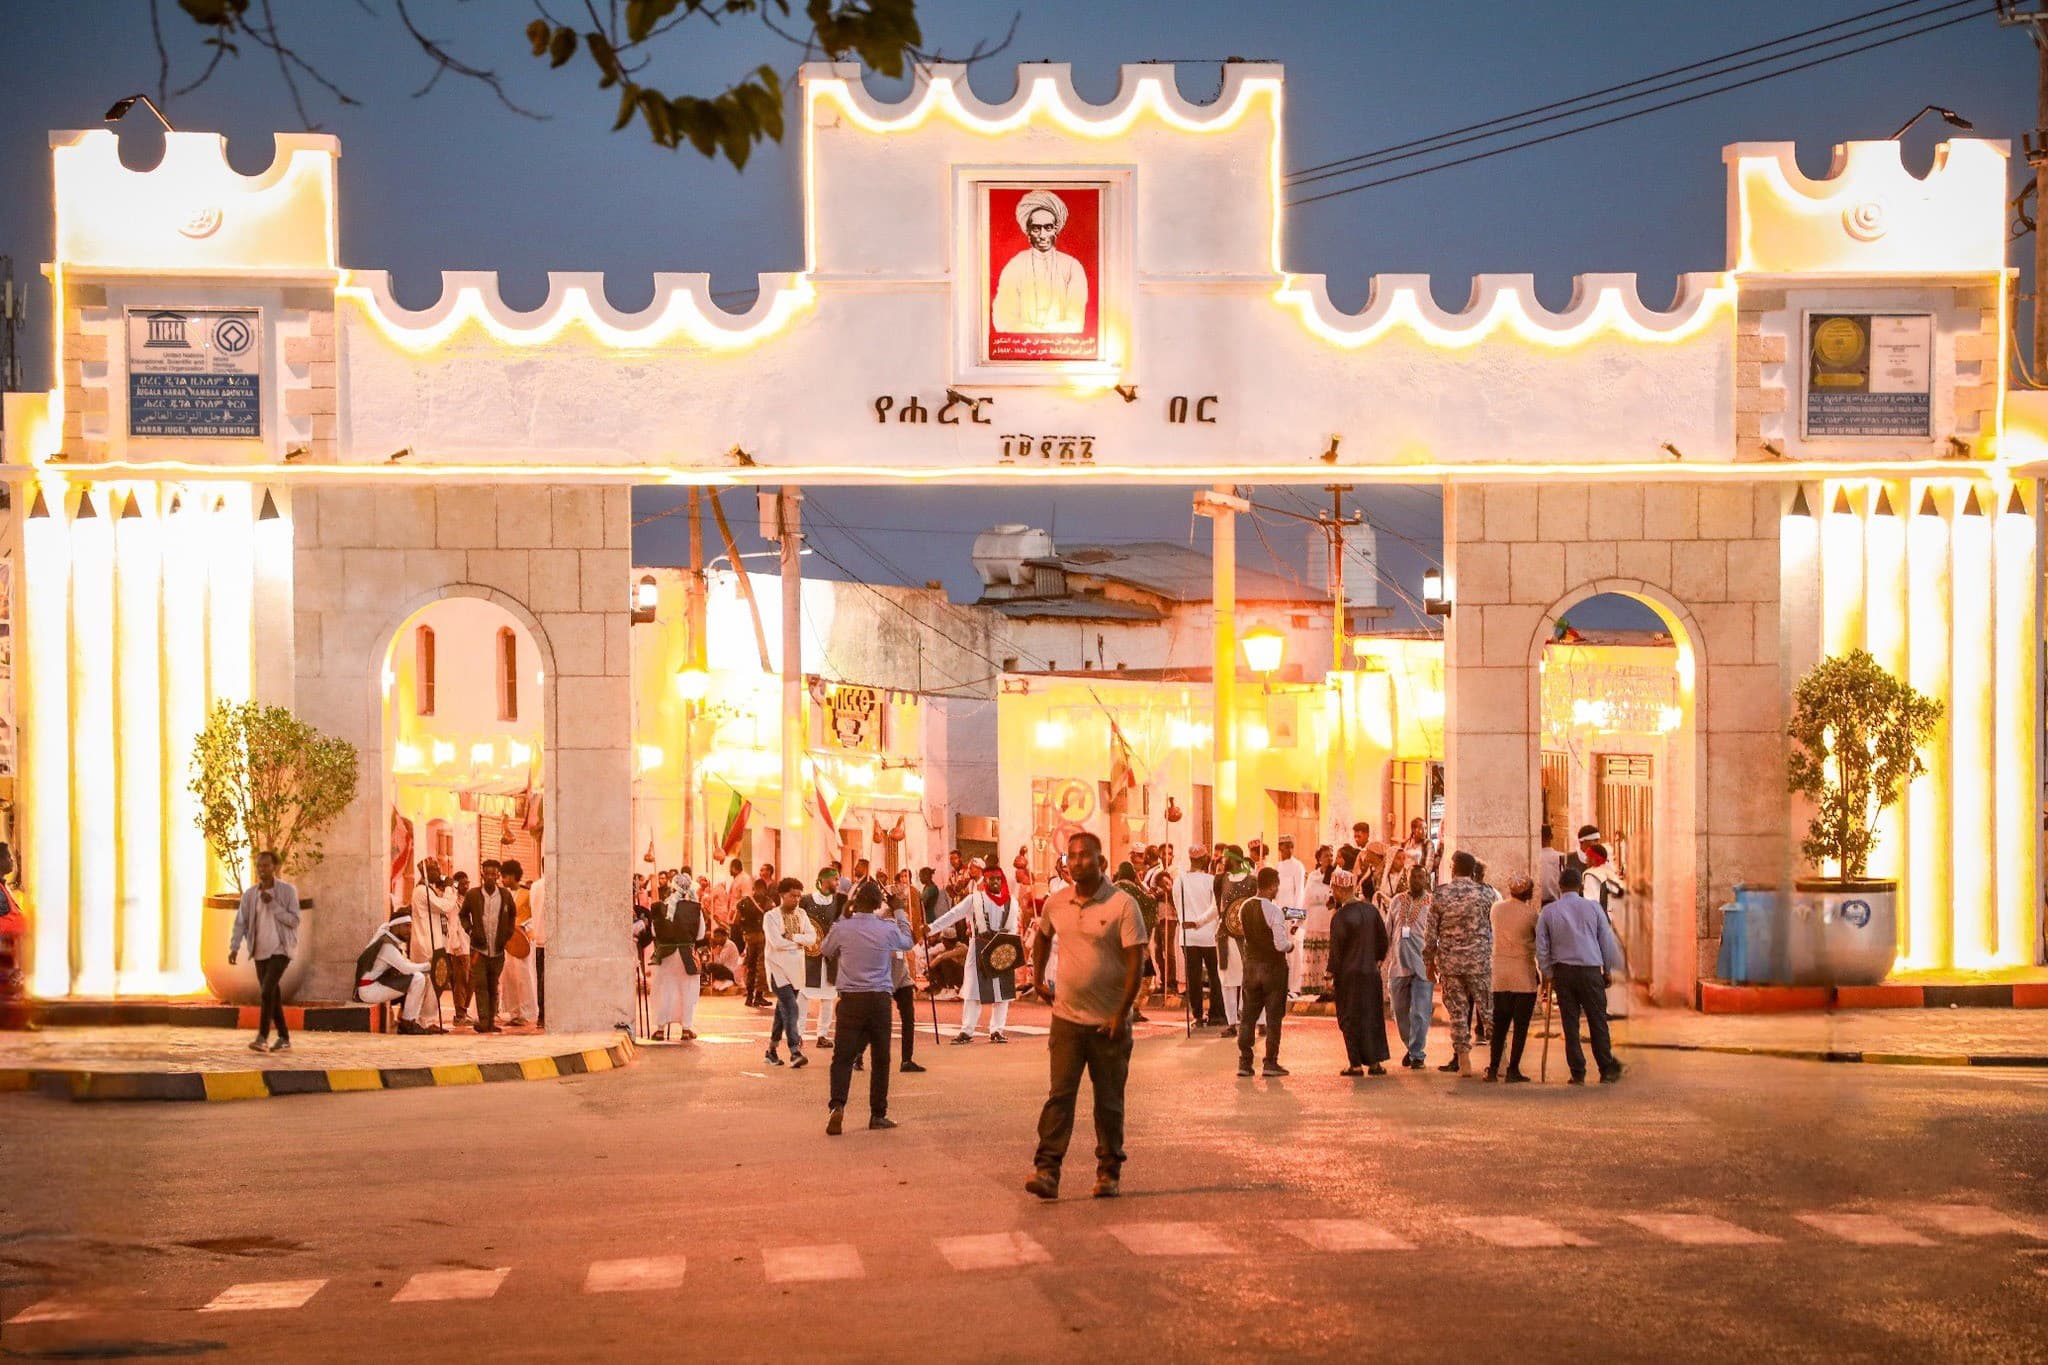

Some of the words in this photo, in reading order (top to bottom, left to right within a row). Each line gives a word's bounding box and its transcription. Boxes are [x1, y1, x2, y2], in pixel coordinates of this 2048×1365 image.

[875, 395, 994, 424] የሐረር
[1169, 395, 1218, 424] በር
[136, 425, 162, 434] HARAR
[190, 425, 218, 434] WORLD
[219, 425, 254, 434] HERITAGE
